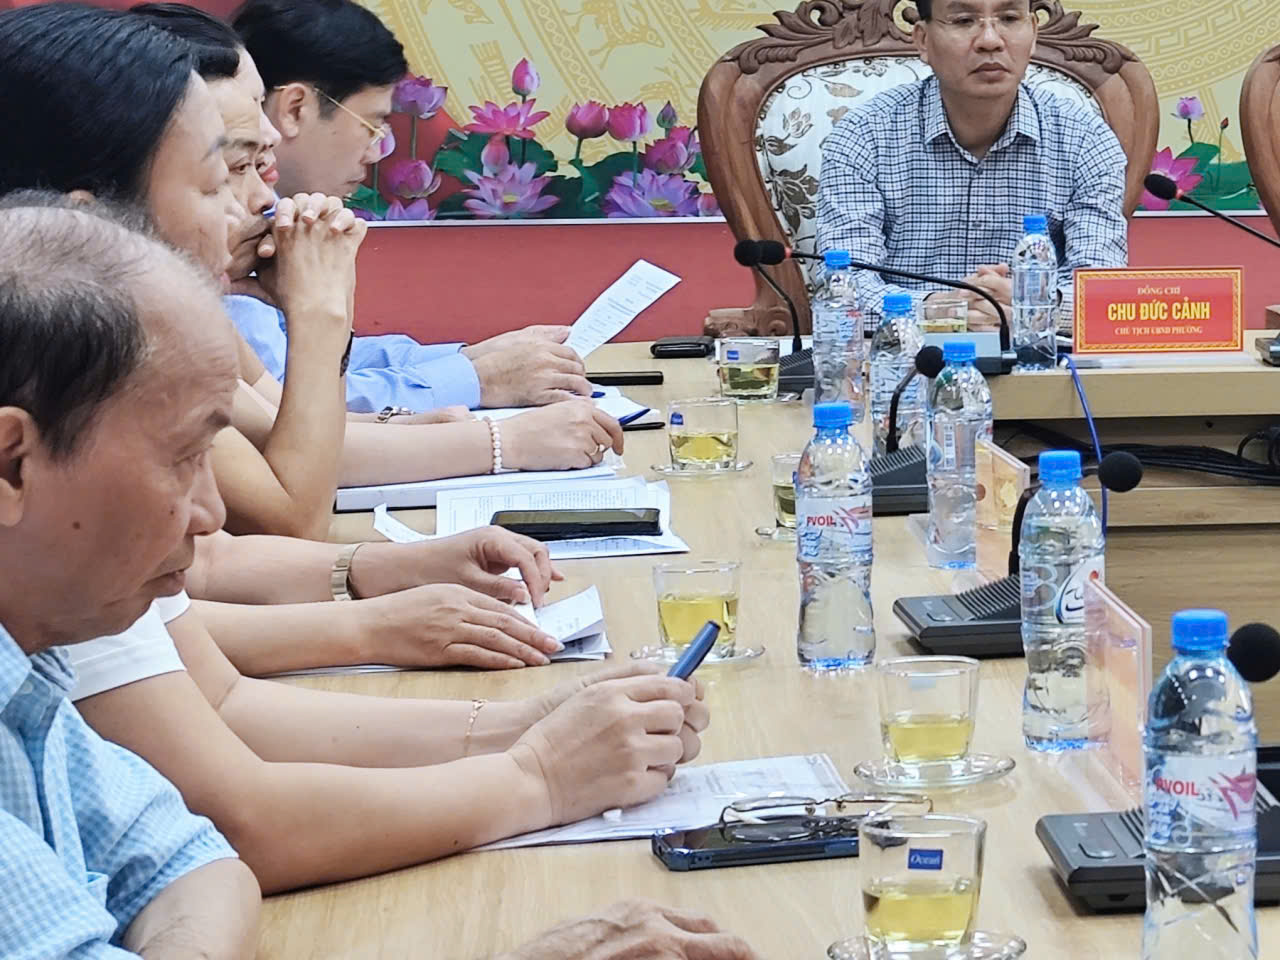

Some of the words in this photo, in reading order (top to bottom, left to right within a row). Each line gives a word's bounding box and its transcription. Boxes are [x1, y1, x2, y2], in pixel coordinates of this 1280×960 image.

[1107, 302, 1136, 321] CHU
[1139, 299, 1168, 320] ĐỨC
[1172, 296, 1211, 320] CẢNH
